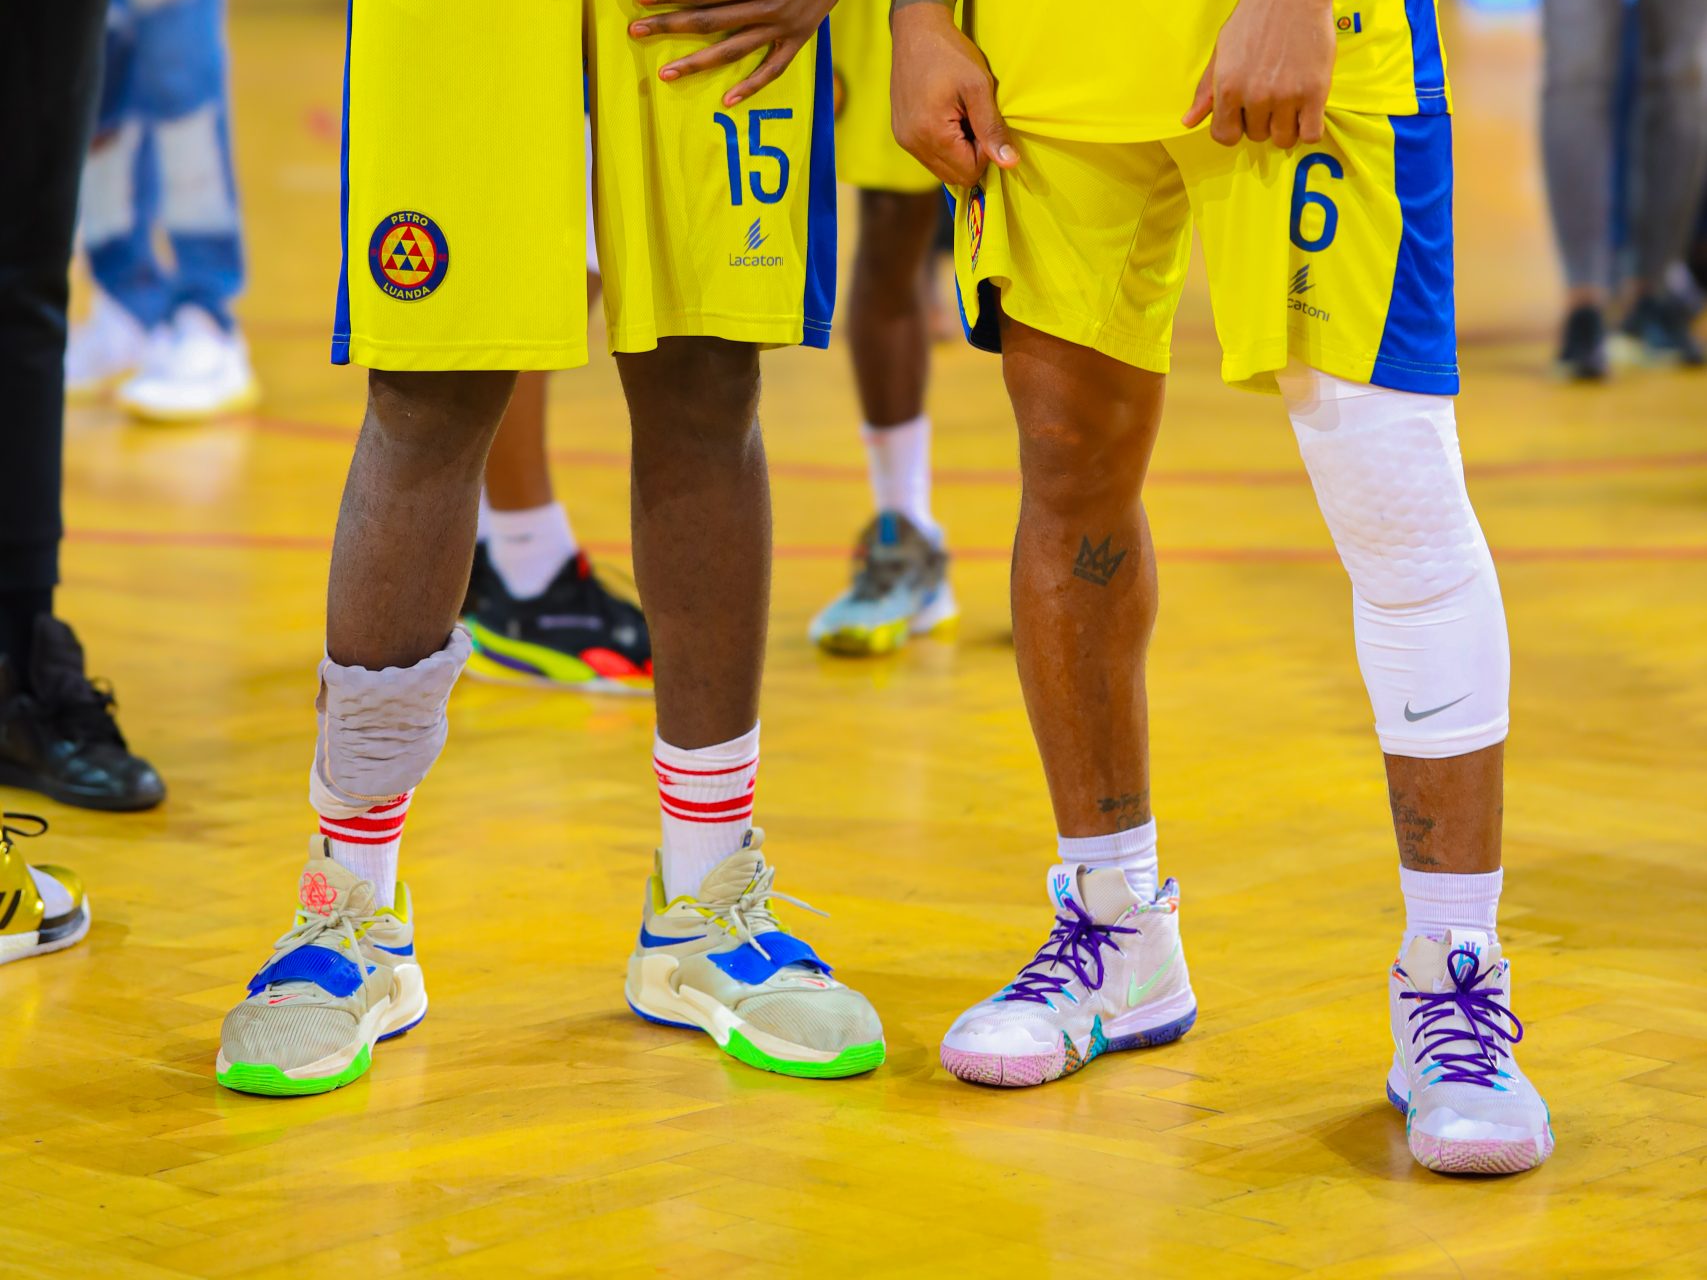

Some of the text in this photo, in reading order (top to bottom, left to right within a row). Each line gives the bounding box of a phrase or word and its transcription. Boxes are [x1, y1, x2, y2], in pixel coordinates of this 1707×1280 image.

[713, 108, 793, 206] 15
[1289, 152, 1344, 252] 6
[391, 213, 429, 227] PETRO
[383, 282, 431, 299] LUANDA
[1287, 297, 1330, 322] catoni
